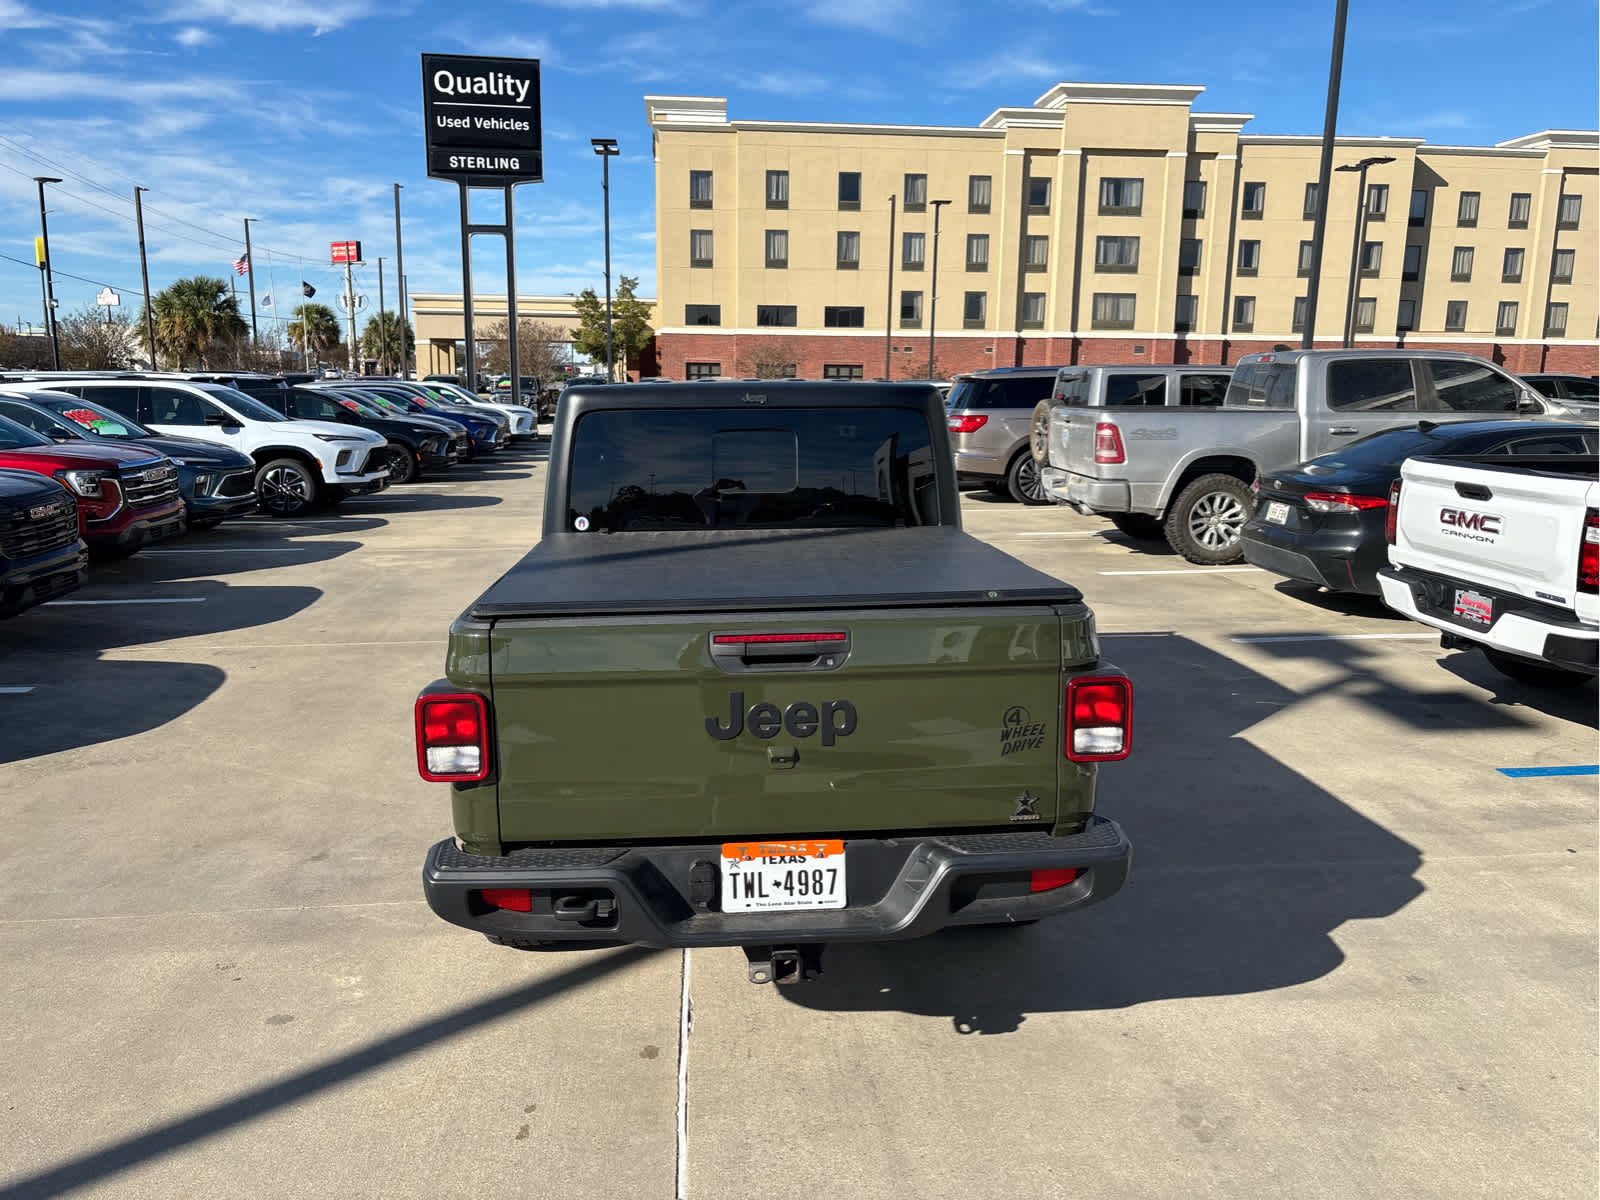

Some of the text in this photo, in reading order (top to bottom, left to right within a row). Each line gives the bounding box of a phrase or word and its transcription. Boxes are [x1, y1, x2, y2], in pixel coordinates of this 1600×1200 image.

[433, 70, 530, 102] Quality
[436, 115, 530, 131] Used Vehicles
[449, 155, 520, 170] STERLING
[30, 503, 62, 519] GMC
[1440, 508, 1501, 534] GMC
[1441, 528, 1495, 544] CANYON
[704, 691, 858, 747] Jeep
[1007, 709, 1022, 726] 4
[1000, 723, 1047, 743] WHEEL
[1000, 736, 1045, 757] DRIVE
[761, 855, 807, 865] TEXAS
[729, 868, 837, 899] TWL 4987
